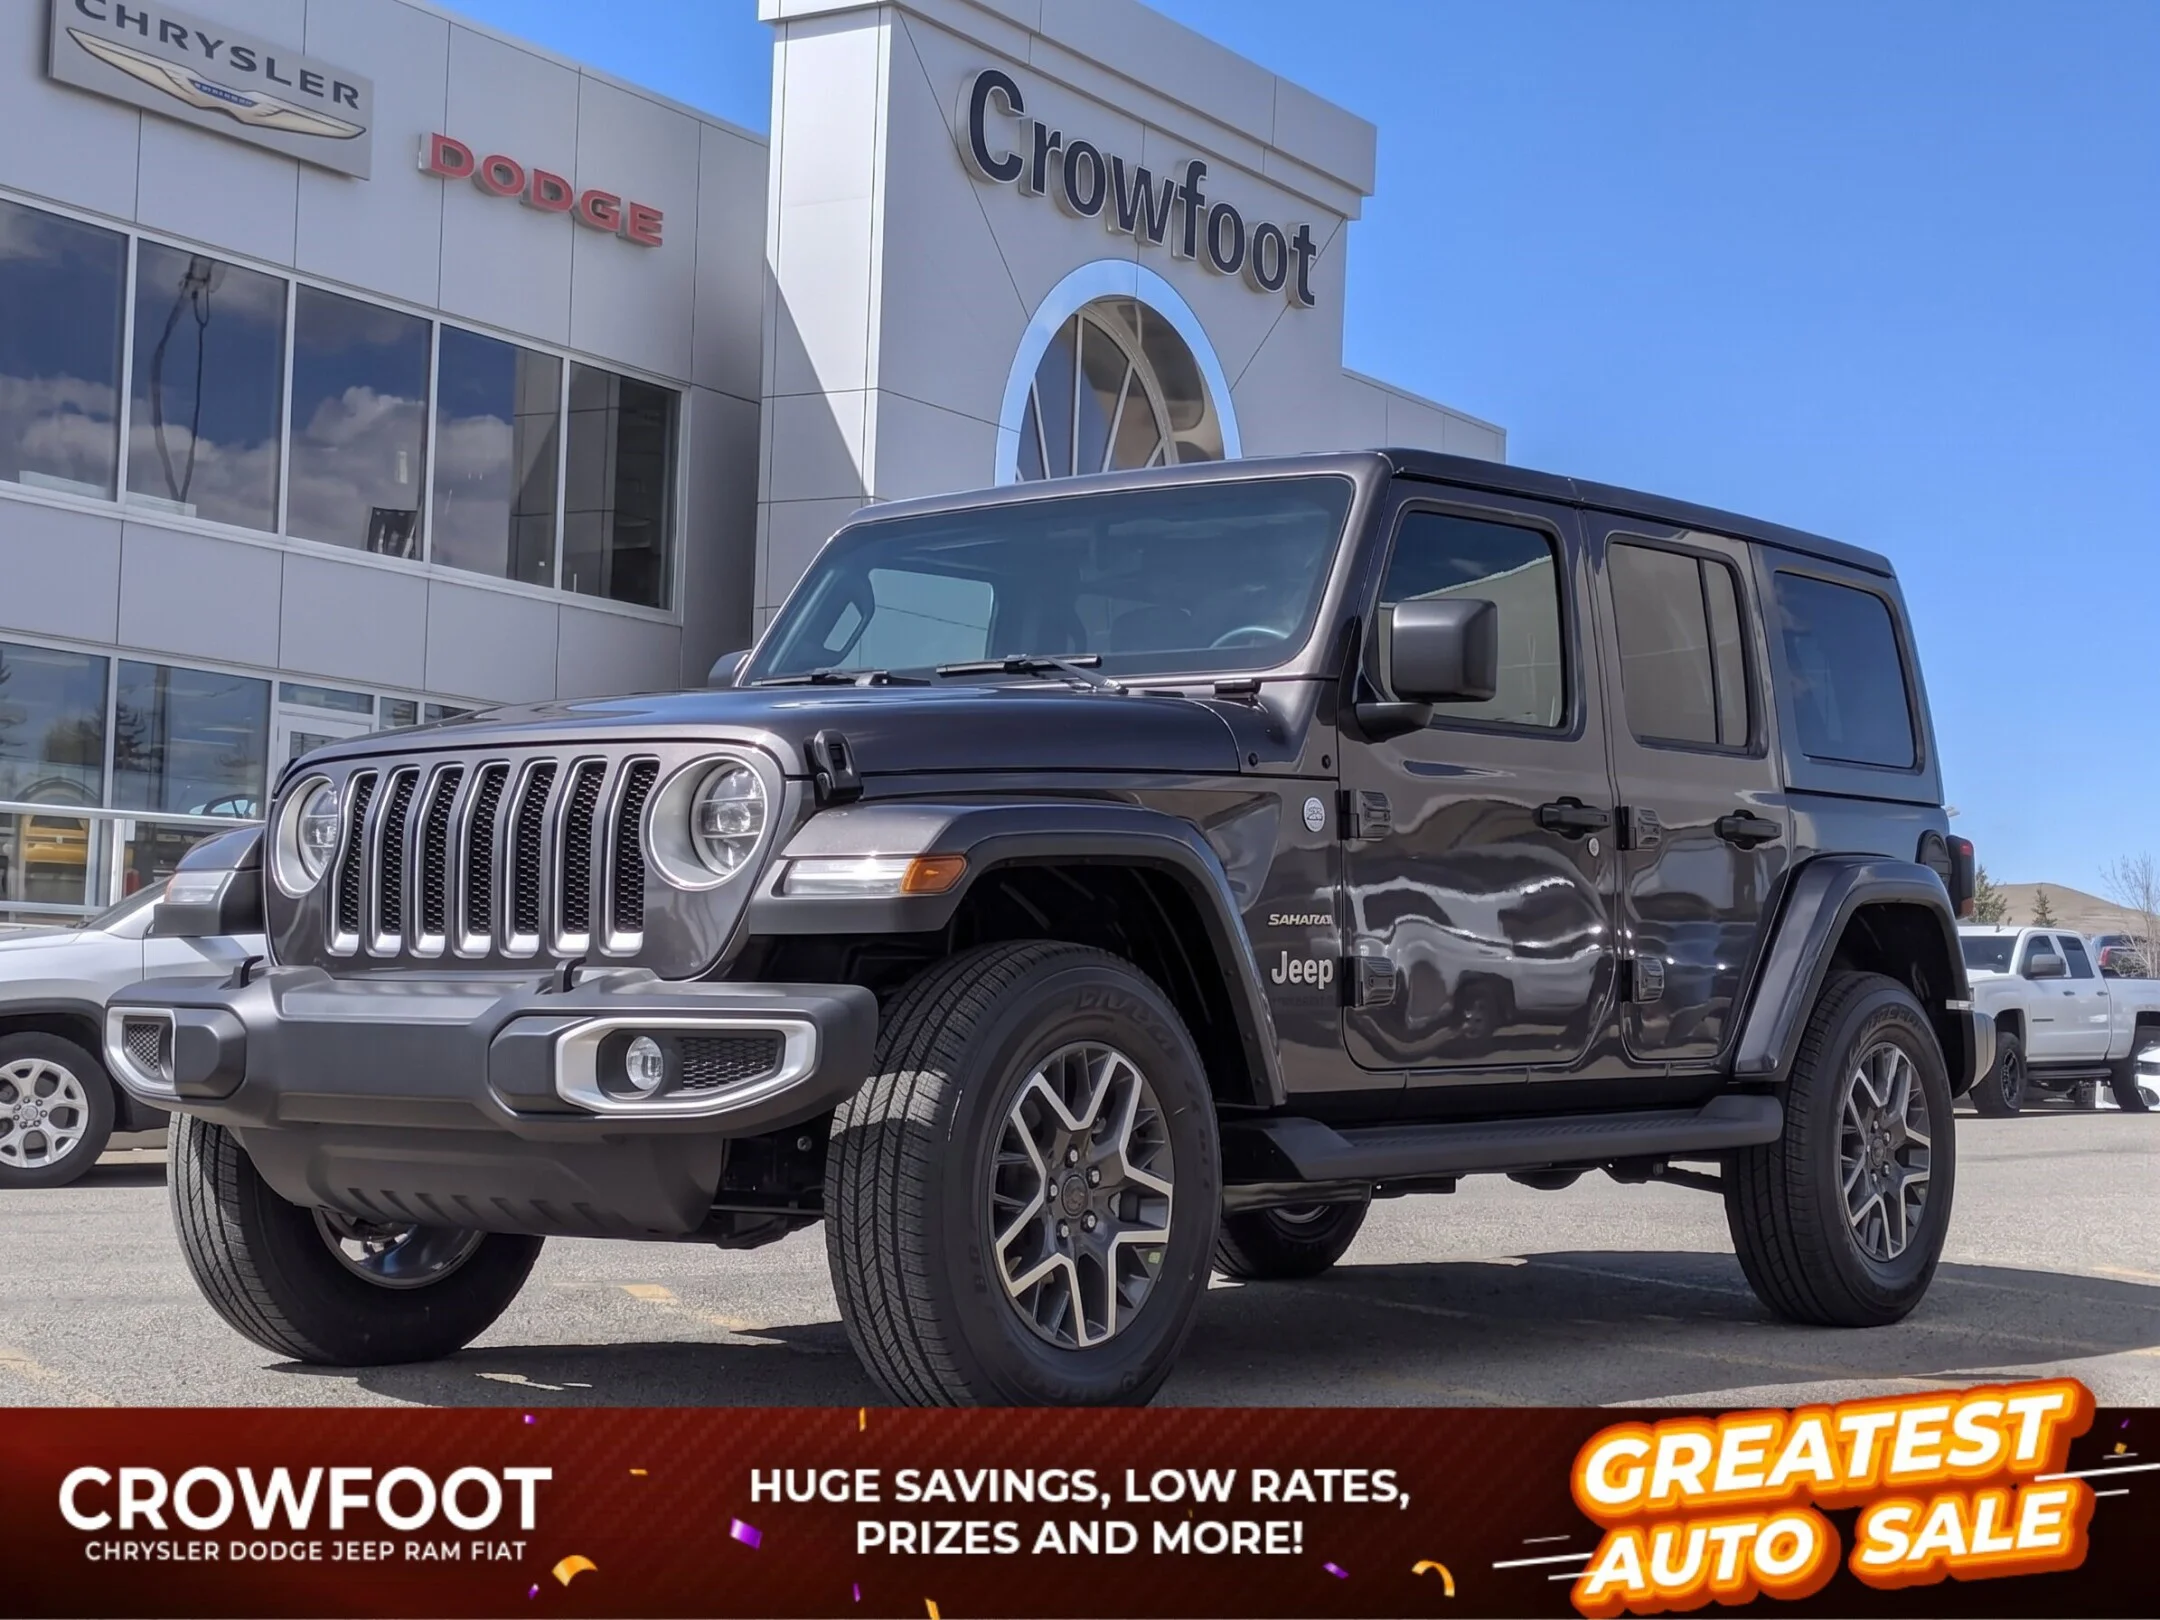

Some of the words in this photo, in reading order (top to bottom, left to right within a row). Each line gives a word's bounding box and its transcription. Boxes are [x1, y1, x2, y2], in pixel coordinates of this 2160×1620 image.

[75, 0, 359, 110] CHRYSLER
[420, 131, 664, 248] DODGE
[963, 67, 1317, 309] Crowfoot
[1267, 912, 1334, 927] SAHARA
[1270, 950, 1335, 990] Jeep
